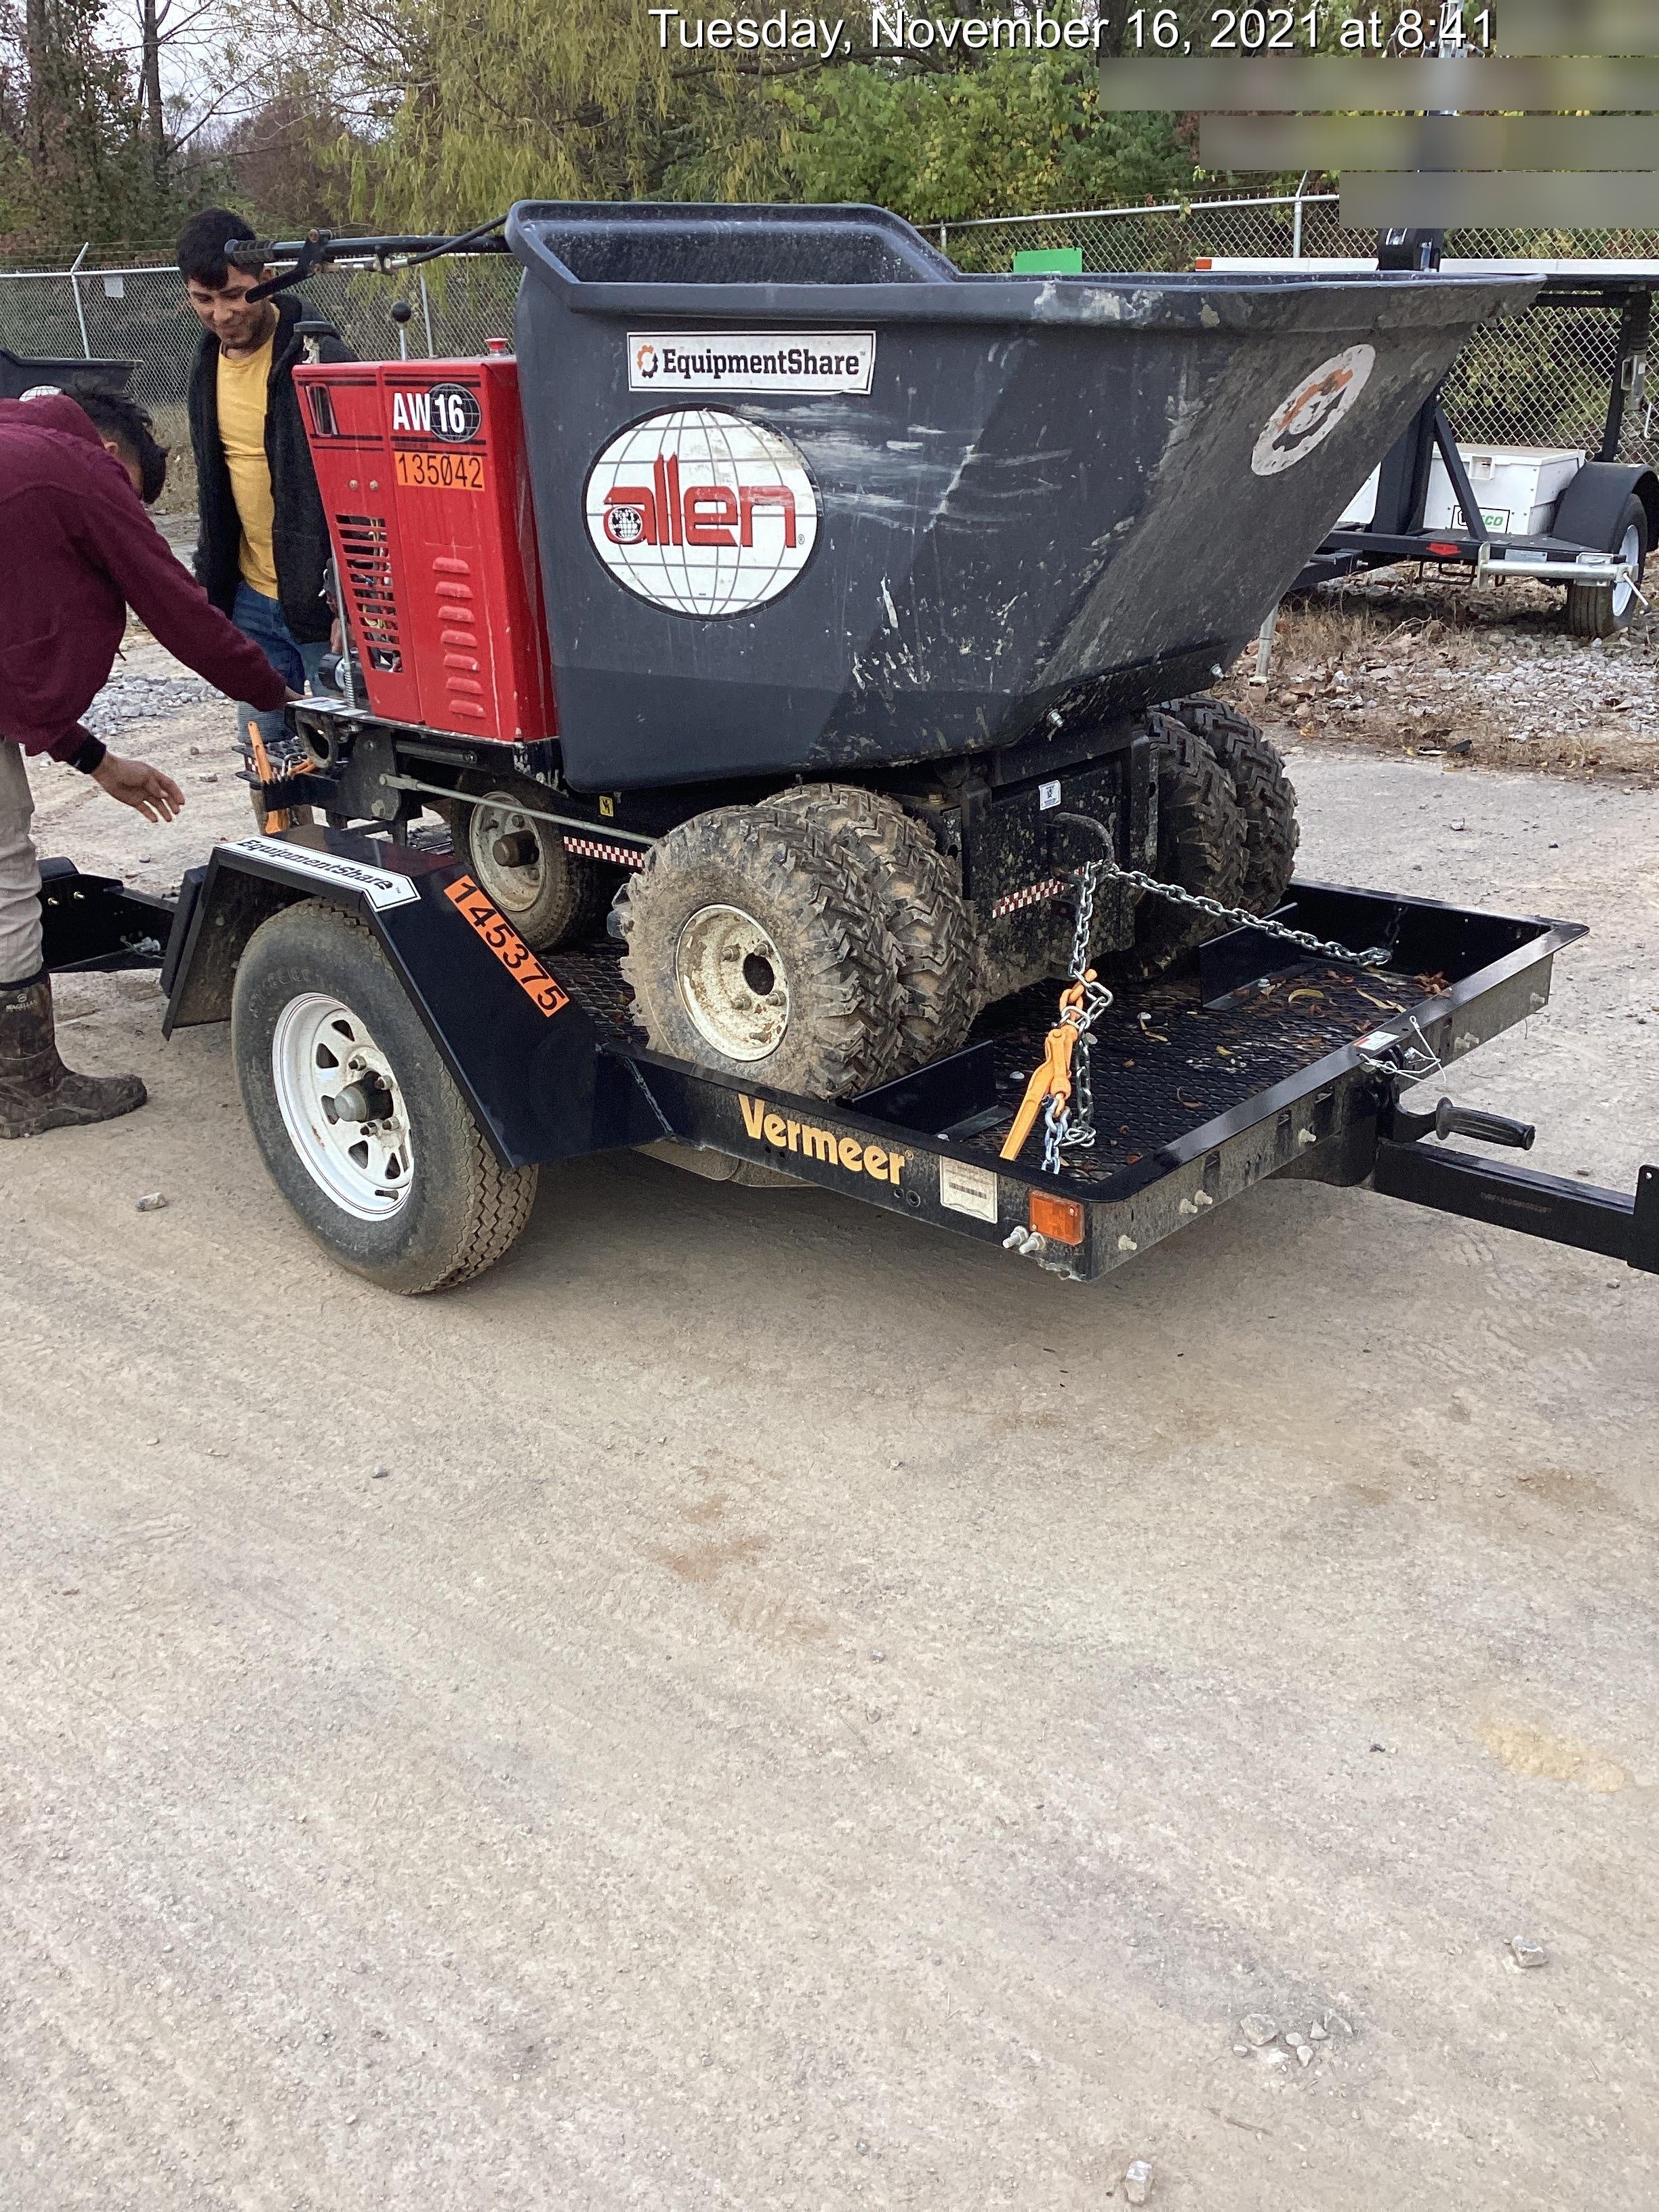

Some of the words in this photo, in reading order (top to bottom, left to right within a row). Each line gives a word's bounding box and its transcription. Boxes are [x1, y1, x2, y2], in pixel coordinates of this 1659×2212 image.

[662, 348, 860, 380] EquipmentShare
[398, 452, 483, 489] 135042
[602, 450, 798, 548] allen
[235, 839, 395, 891] EquipmentShare
[454, 882, 567, 1011] 145375
[737, 1093, 907, 1185] Vermeer
